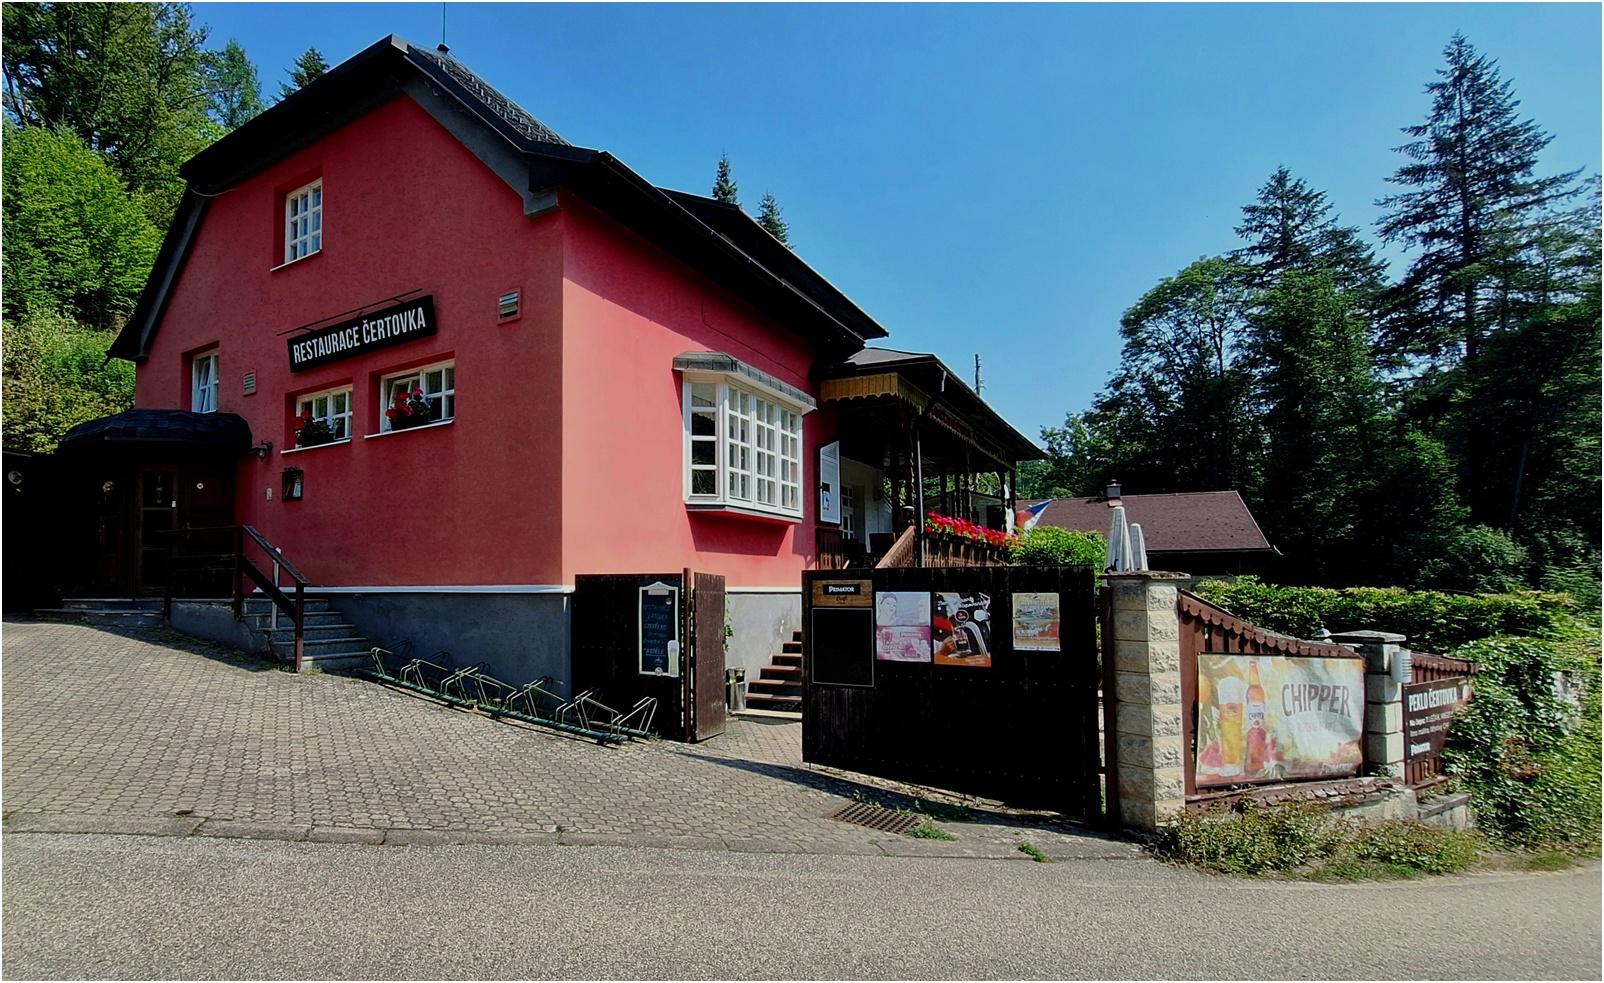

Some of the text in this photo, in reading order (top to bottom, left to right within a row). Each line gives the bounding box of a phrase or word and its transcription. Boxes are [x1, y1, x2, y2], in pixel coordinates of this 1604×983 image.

[293, 307, 426, 364] RESTAURACE ČERTOVKA
[1281, 683, 1351, 718] CHIPPER
[1408, 692, 1428, 712] PEKLO
